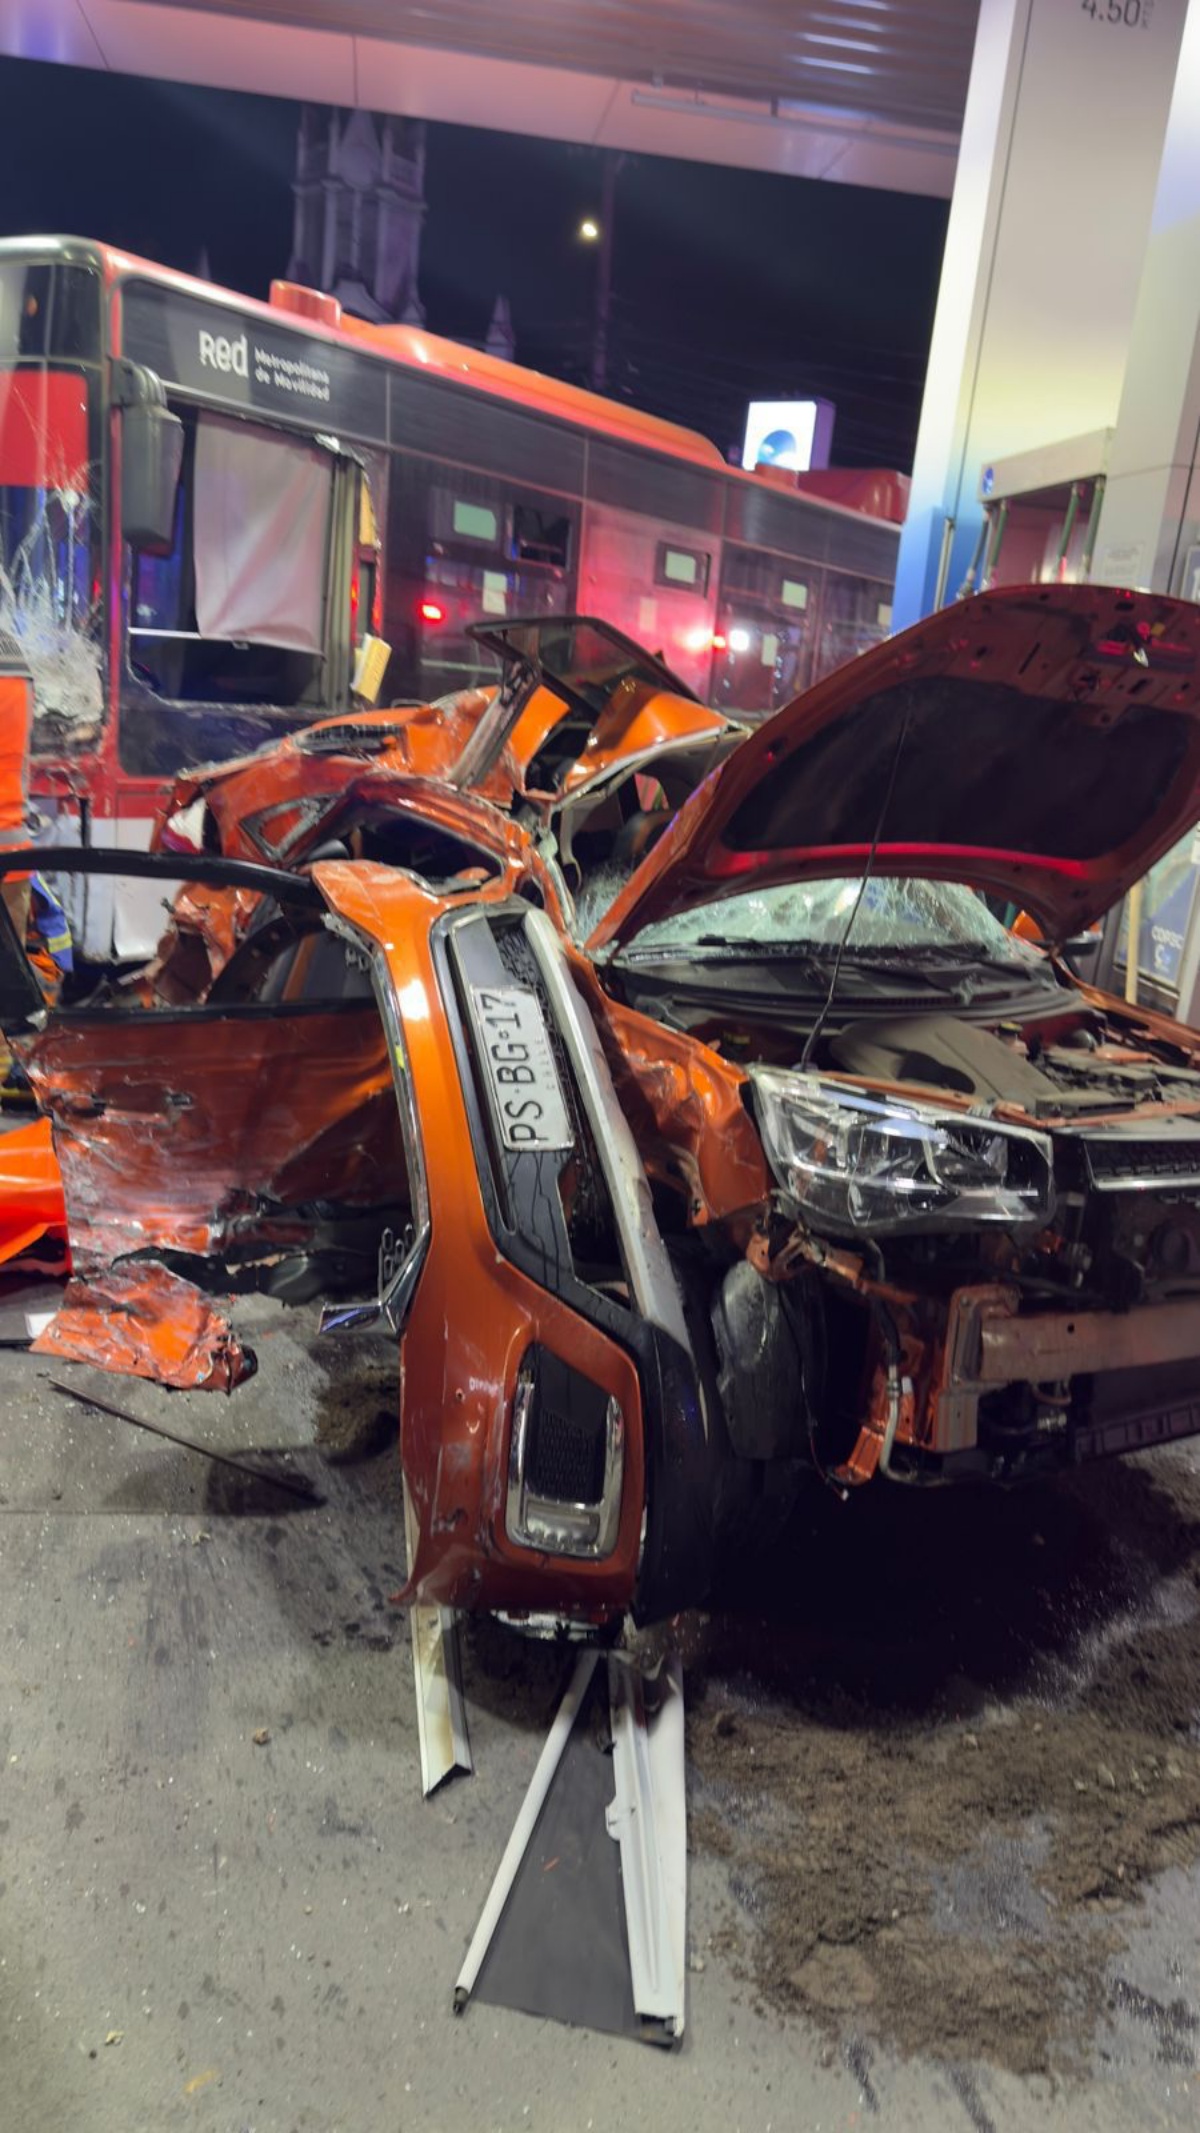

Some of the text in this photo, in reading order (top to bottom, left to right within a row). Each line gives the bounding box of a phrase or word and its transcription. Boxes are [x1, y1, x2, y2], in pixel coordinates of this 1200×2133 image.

[1081, 0, 1141, 28] 4.50
[199, 329, 248, 378] Red
[254, 366, 330, 402] de Movilidad
